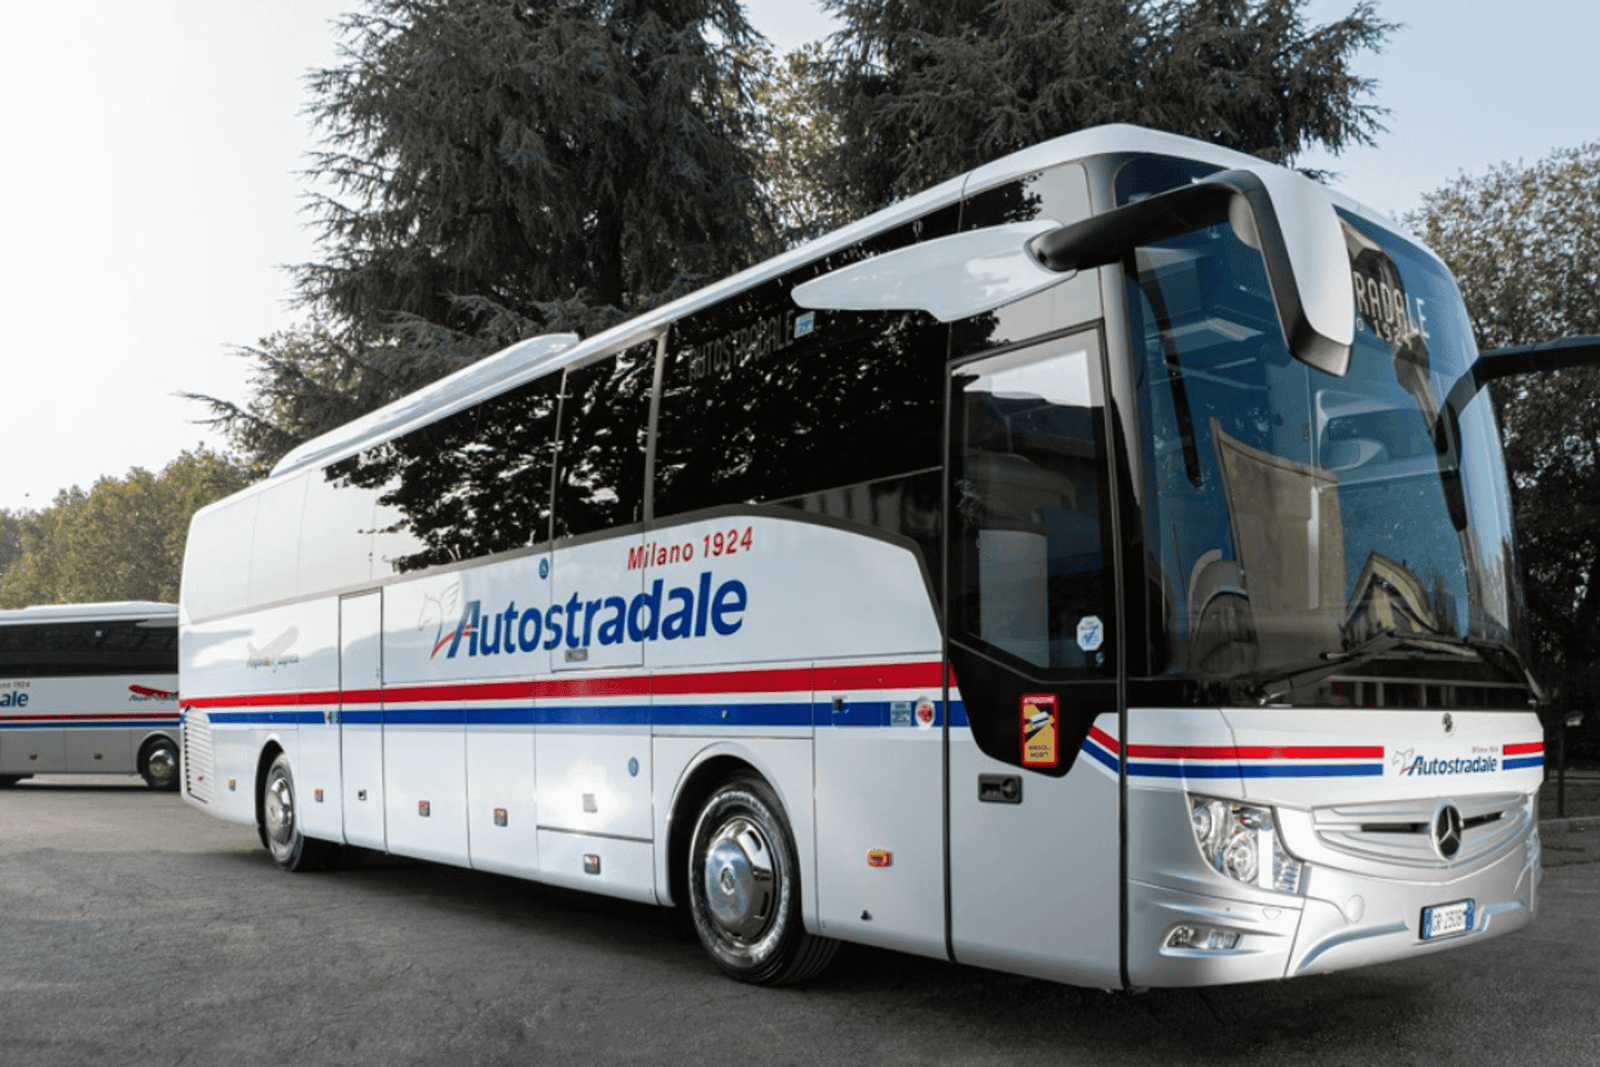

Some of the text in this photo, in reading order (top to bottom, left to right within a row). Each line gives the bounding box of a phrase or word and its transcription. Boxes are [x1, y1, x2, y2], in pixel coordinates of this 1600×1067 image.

[1353, 270, 1431, 339] RADALE
[627, 526, 753, 571] Milano 1924
[446, 571, 748, 659] Autostradale
[0, 690, 29, 707] ale
[1408, 755, 1497, 775] Autostradale
